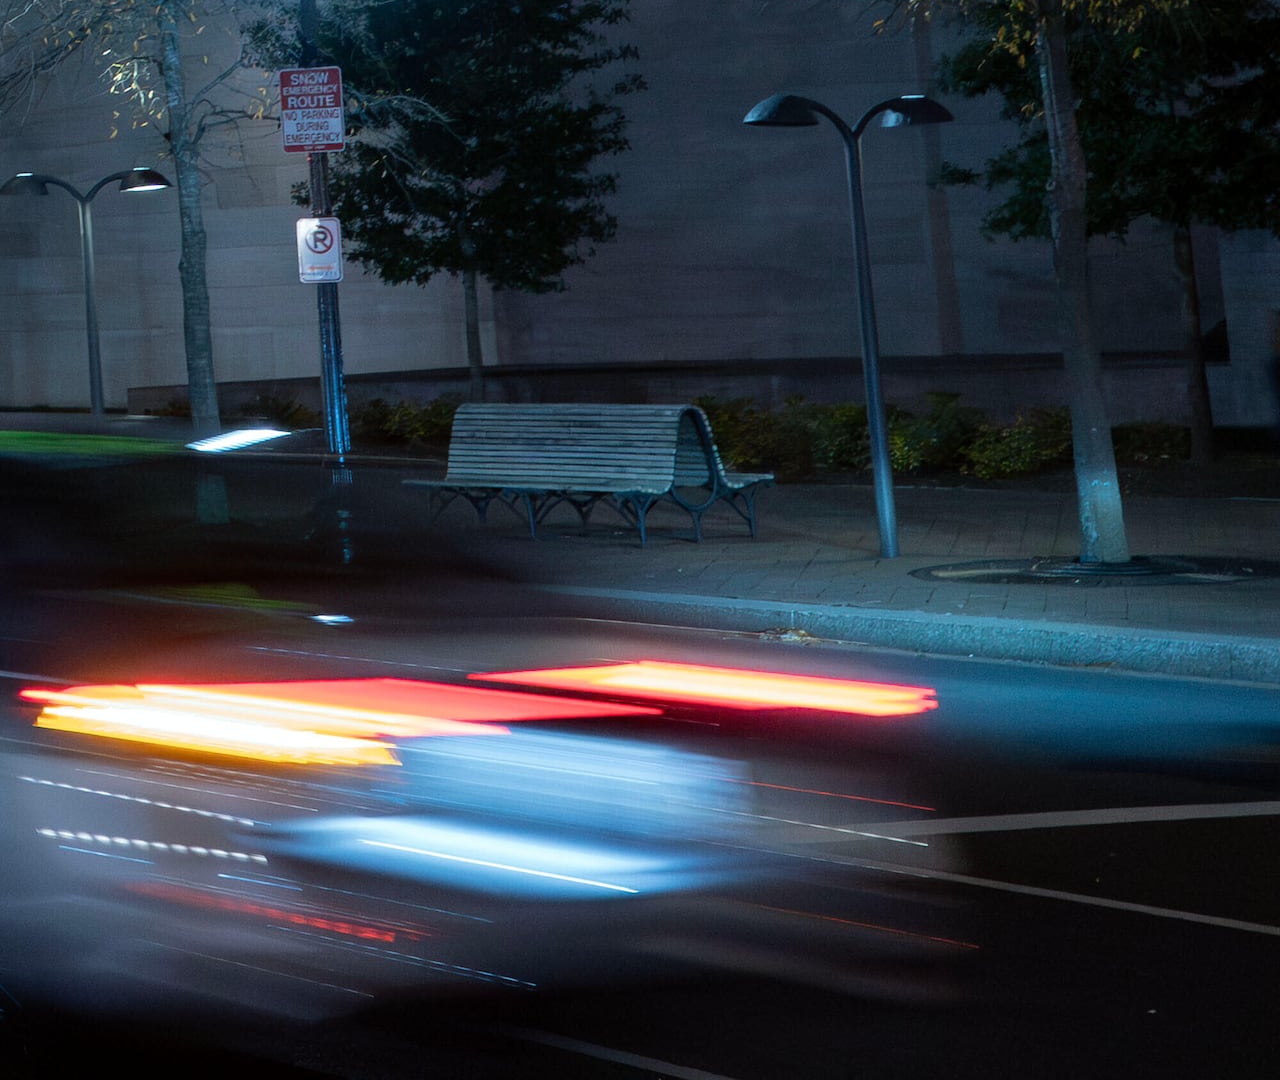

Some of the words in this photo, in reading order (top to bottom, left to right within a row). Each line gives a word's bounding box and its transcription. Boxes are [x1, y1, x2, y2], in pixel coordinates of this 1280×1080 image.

[290, 72, 328, 85] SNOW
[283, 84, 338, 96] EMERGENCY
[287, 95, 335, 109] ROUTE
[285, 111, 298, 121] NO
[301, 109, 340, 120] PARKING
[296, 120, 329, 132] DURING
[286, 132, 340, 144] EMERGENCY
